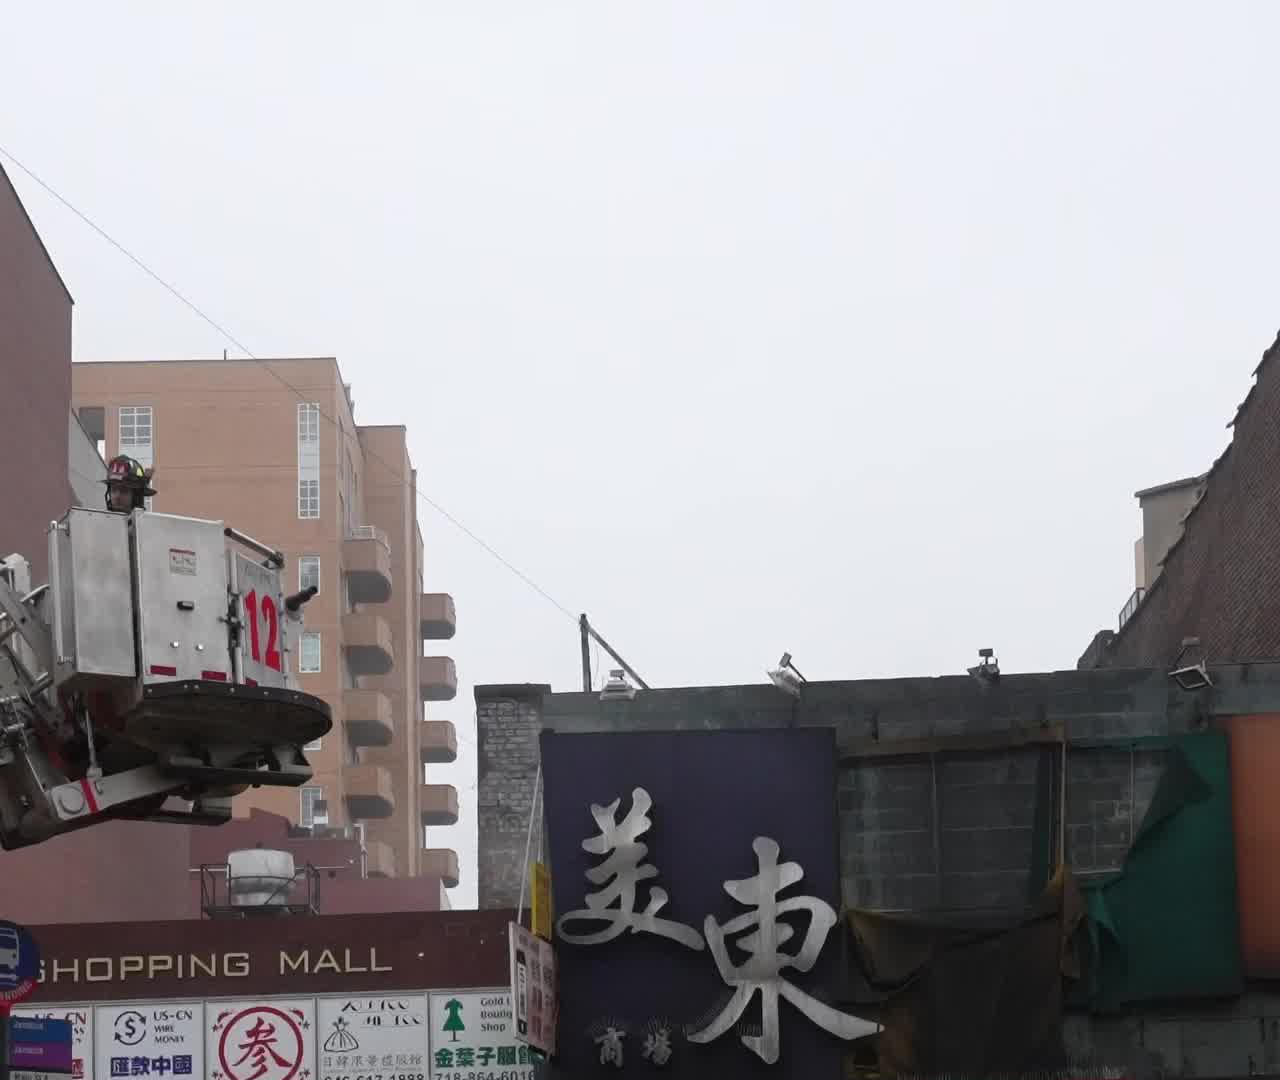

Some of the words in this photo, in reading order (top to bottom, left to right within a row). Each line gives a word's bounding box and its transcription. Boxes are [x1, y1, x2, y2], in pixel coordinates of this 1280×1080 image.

[245, 590, 281, 672] 12
[280, 946, 393, 975] MALL
[153, 1010, 193, 1022] US-CN
[481, 1010, 513, 1020] Boutiq
[155, 1025, 174, 1033] WIRE
[481, 1023, 506, 1032] Shop
[110, 1055, 193, 1078] 匯款中國
